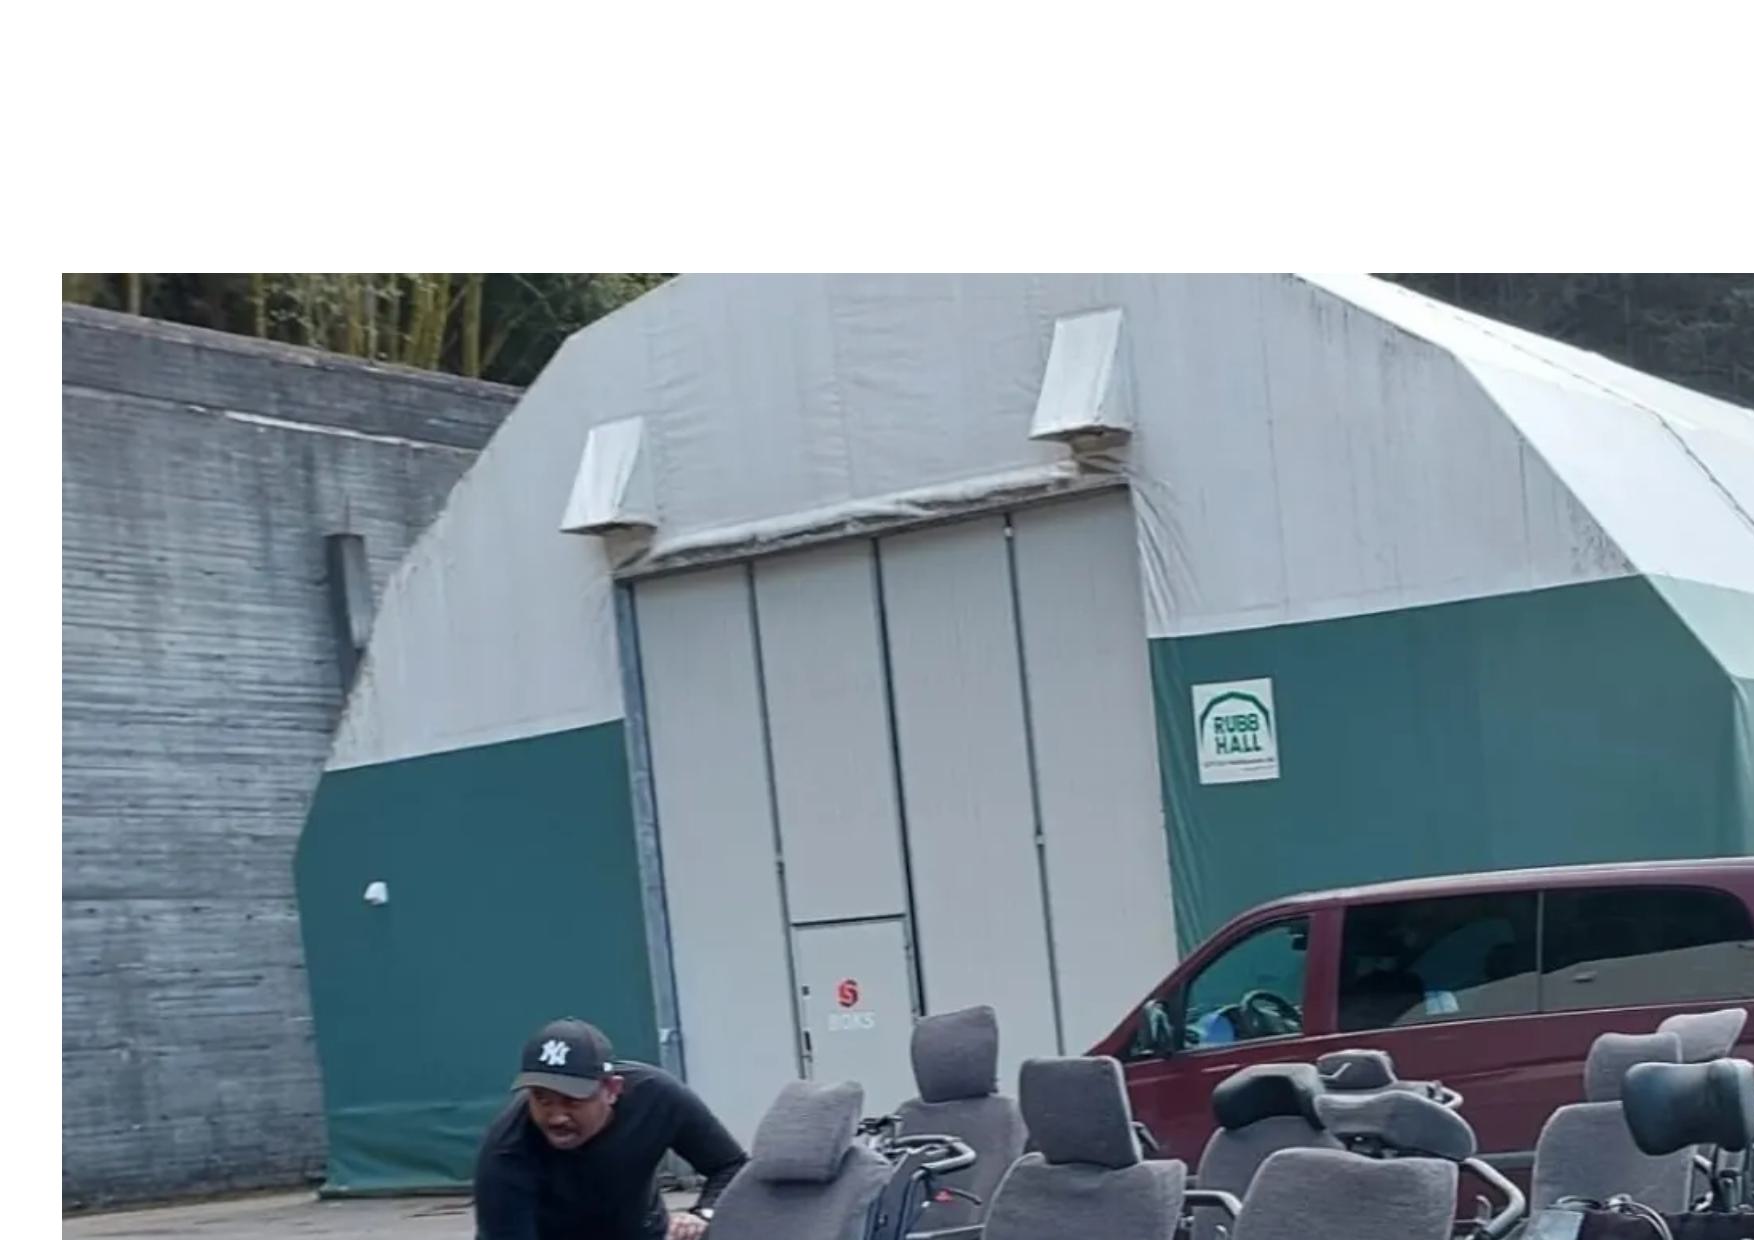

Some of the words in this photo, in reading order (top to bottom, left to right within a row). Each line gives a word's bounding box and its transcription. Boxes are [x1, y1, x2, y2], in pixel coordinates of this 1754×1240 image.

[1214, 713, 1259, 734] RUBB
[1215, 733, 1262, 754] HALL
[538, 1040, 571, 1066] NY
